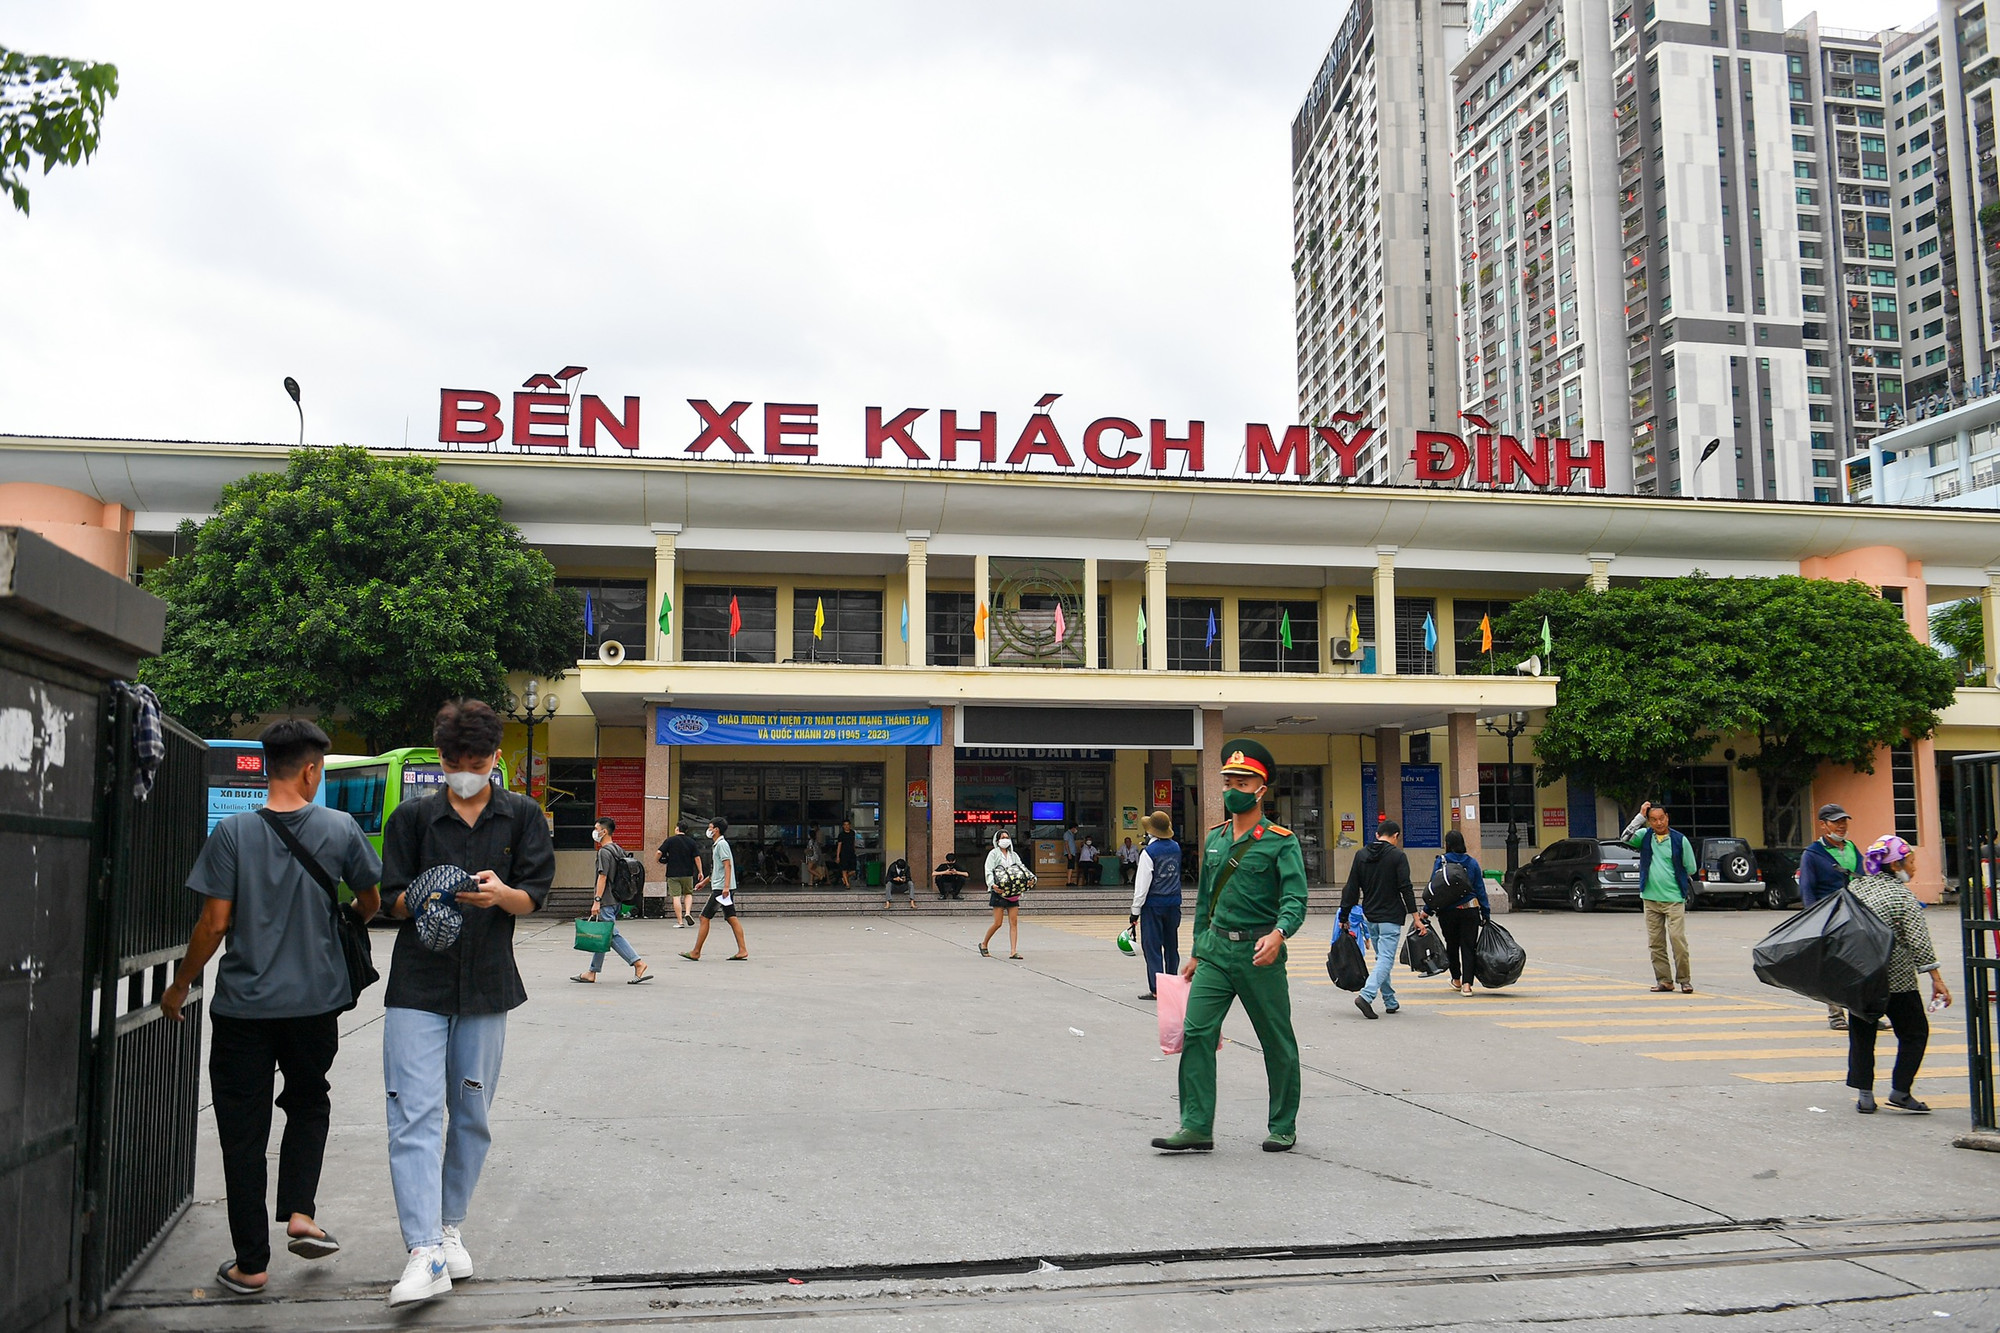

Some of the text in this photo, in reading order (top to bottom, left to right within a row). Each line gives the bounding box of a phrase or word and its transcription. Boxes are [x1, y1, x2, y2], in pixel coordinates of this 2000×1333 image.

[439, 366, 1605, 488] BẾN XE KHÁCH MỸ ĐÌNH
[717, 713, 739, 725] CHÀO
[780, 715, 801, 727] NIỆM
[803, 715, 813, 725] 78
[859, 715, 882, 727] MẠNG
[884, 714, 910, 725] THÁNG
[912, 714, 930, 725] TÁM
[758, 728, 768, 739] VÀ
[770, 726, 792, 739] QUỐC
[794, 728, 821, 739] KHÁNH
[824, 729, 836, 739] 2/9
[838, 729, 860, 740] (1945
[867, 729, 890, 740] 2023)
[405, 773, 415, 782] 212
[235, 790, 252, 799] BUS
[254, 791, 264, 799] 10
[220, 803, 247, 811] Hotline:
